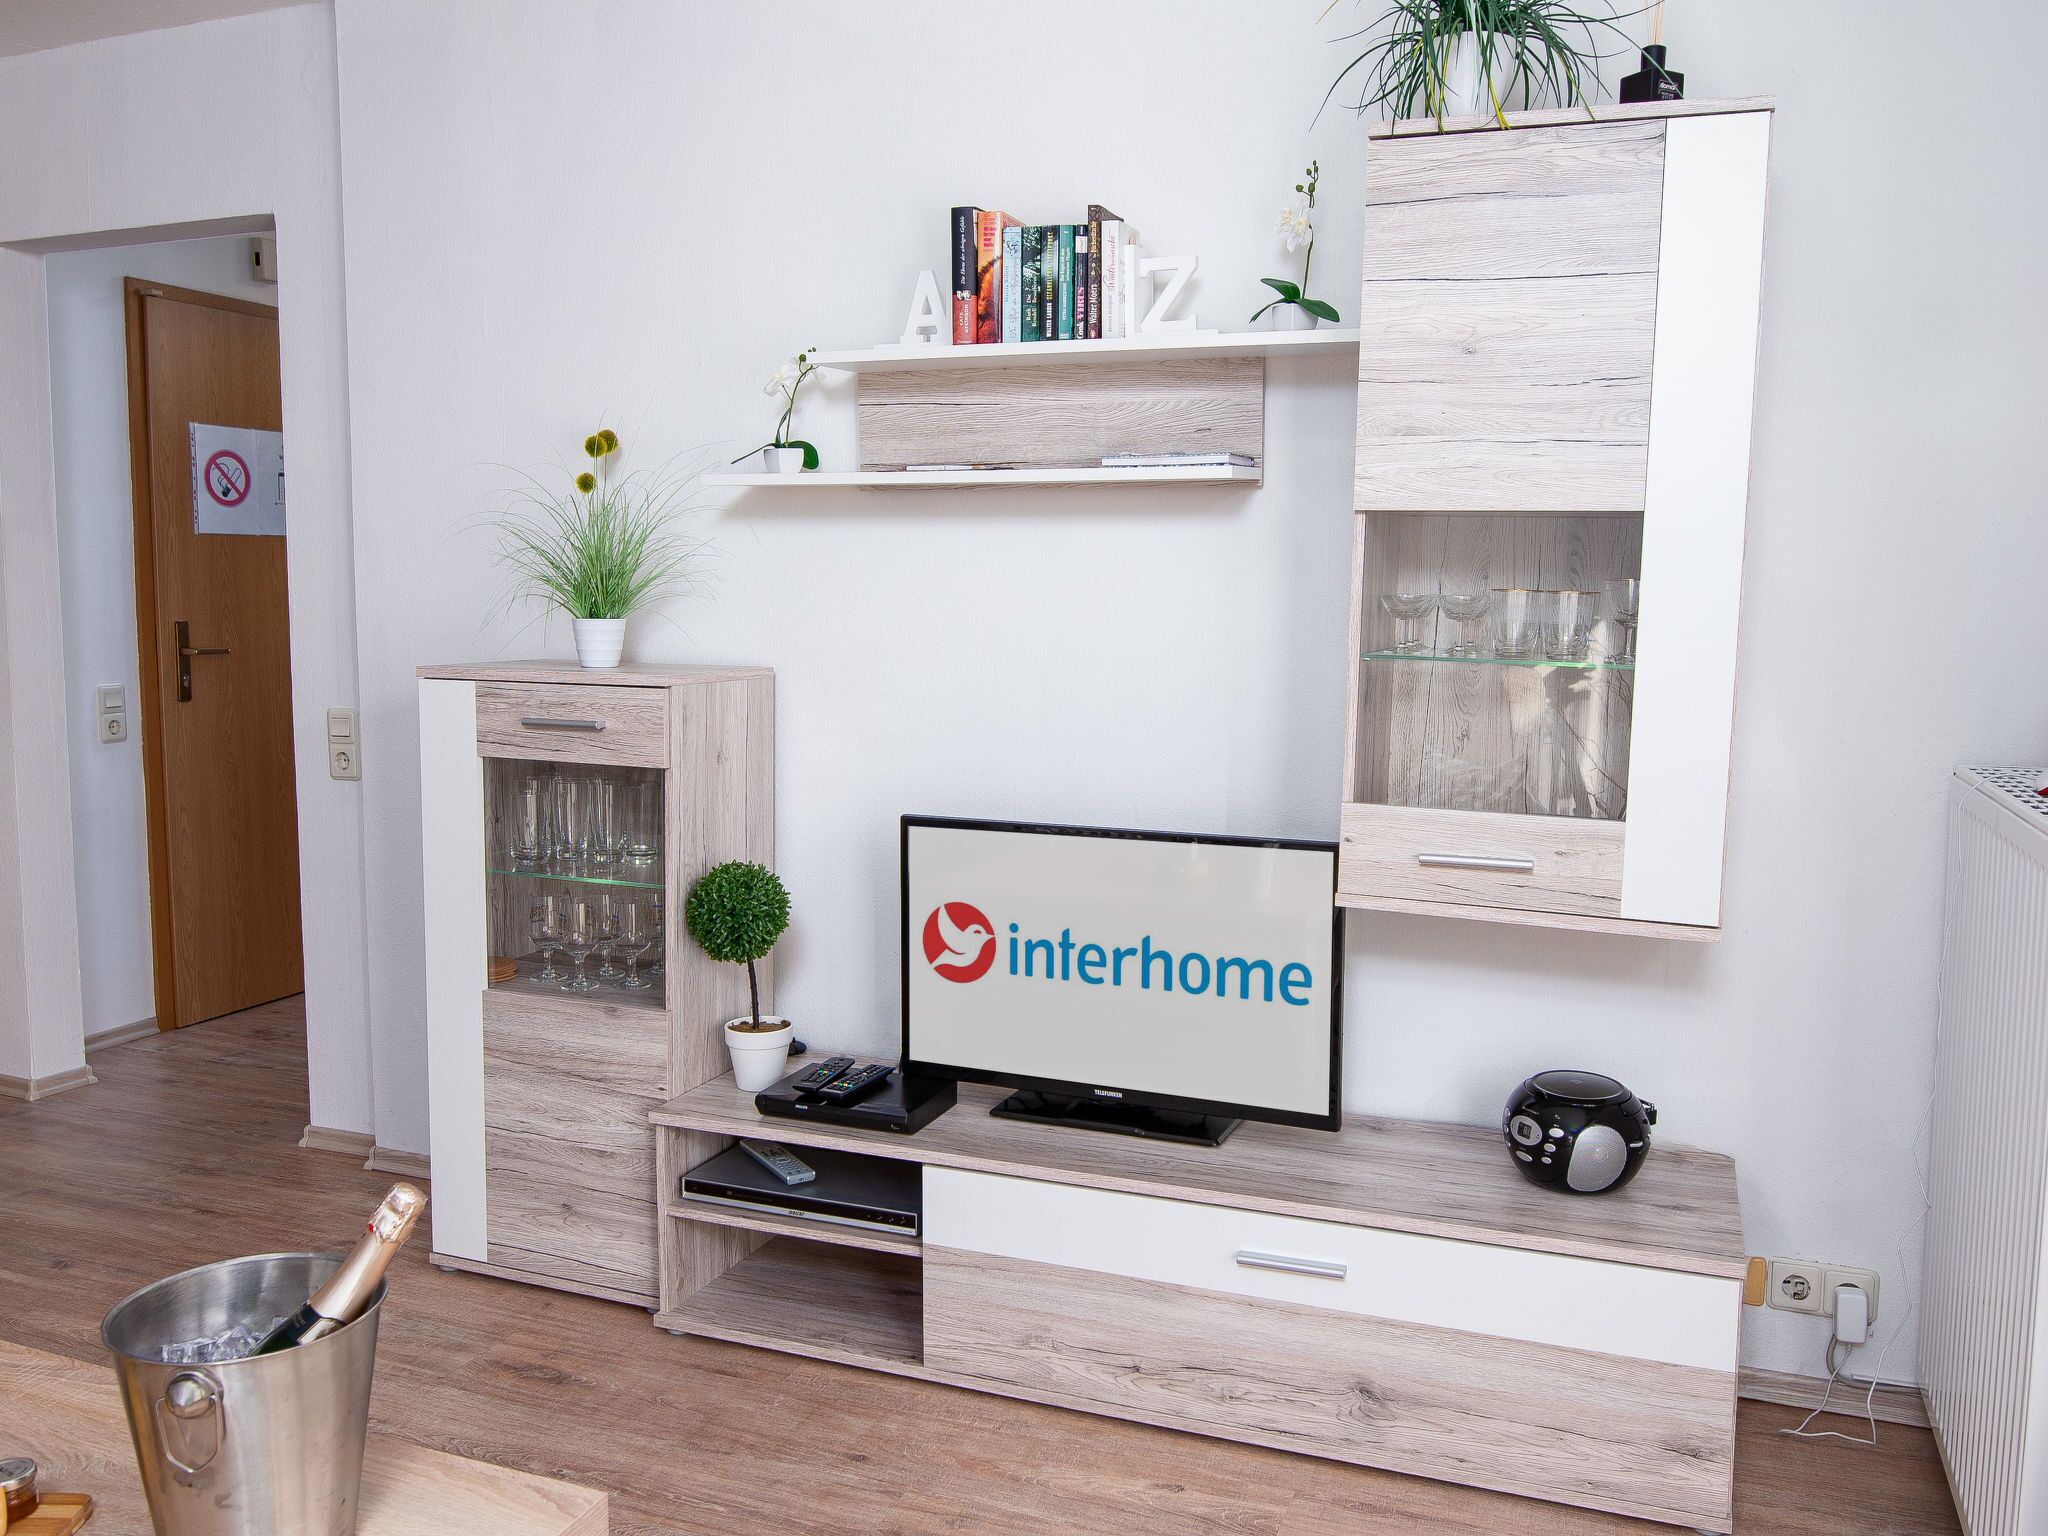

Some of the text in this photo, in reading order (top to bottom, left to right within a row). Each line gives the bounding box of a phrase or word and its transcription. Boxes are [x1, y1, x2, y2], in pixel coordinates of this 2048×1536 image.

[1076, 286, 1085, 320] VIRUS
[1089, 283, 1098, 324] Walter Moers
[1076, 321, 1085, 339] Cook
[1009, 923, 1312, 1006] interhome
[1094, 1089, 1123, 1099] TELEFUNKEN
